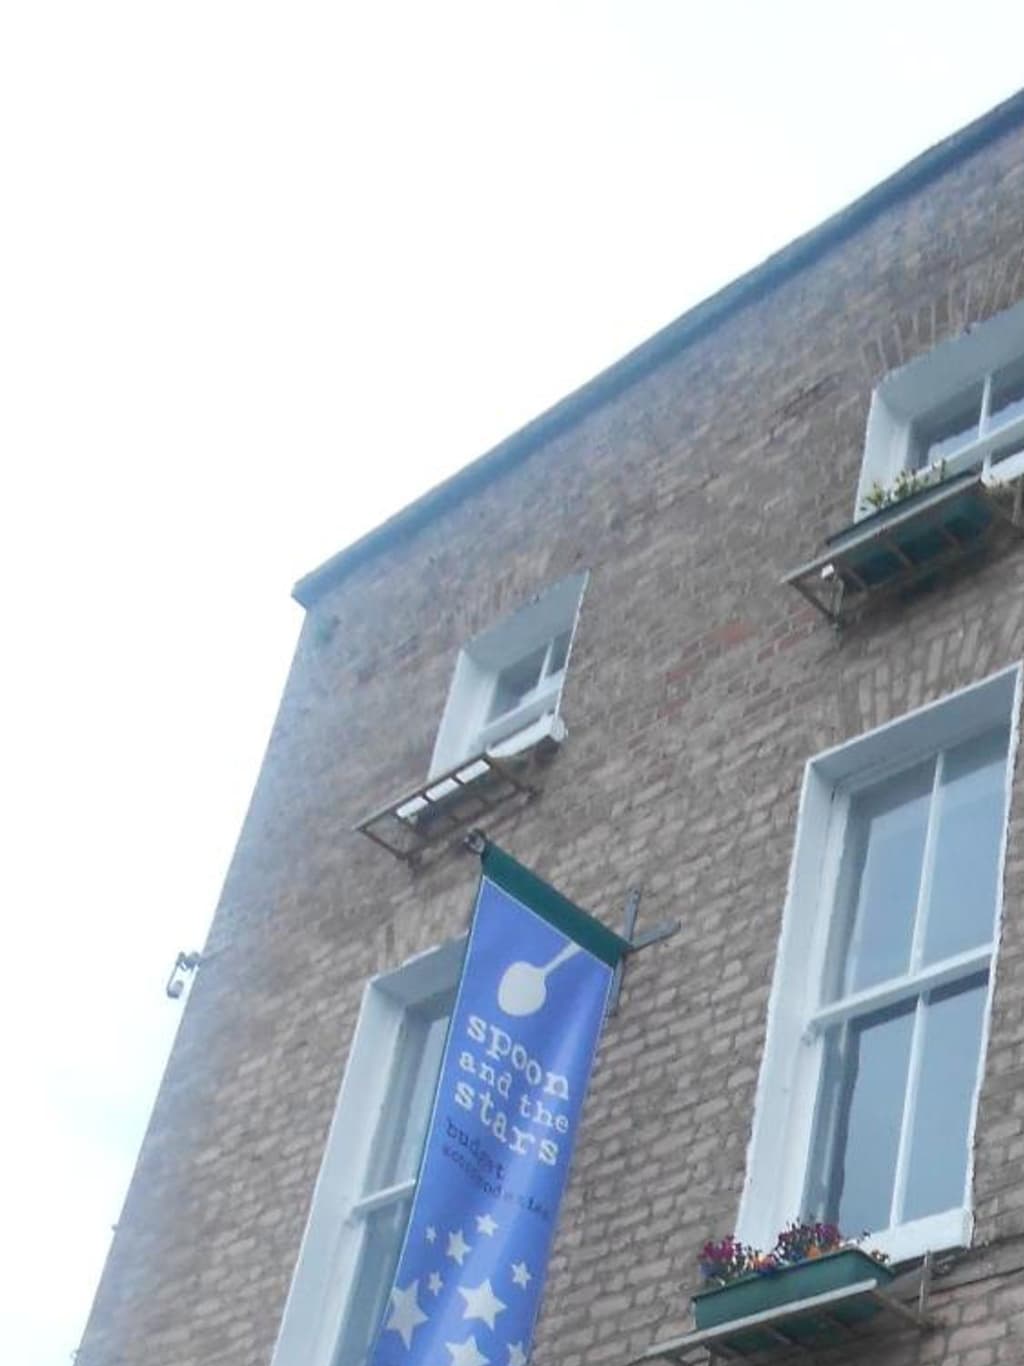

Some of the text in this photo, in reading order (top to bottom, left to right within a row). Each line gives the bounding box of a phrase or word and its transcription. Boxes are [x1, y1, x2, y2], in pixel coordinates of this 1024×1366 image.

[459, 1050, 569, 1134] and the
[467, 1015, 568, 1100] spoon
[454, 1081, 559, 1166] stars
